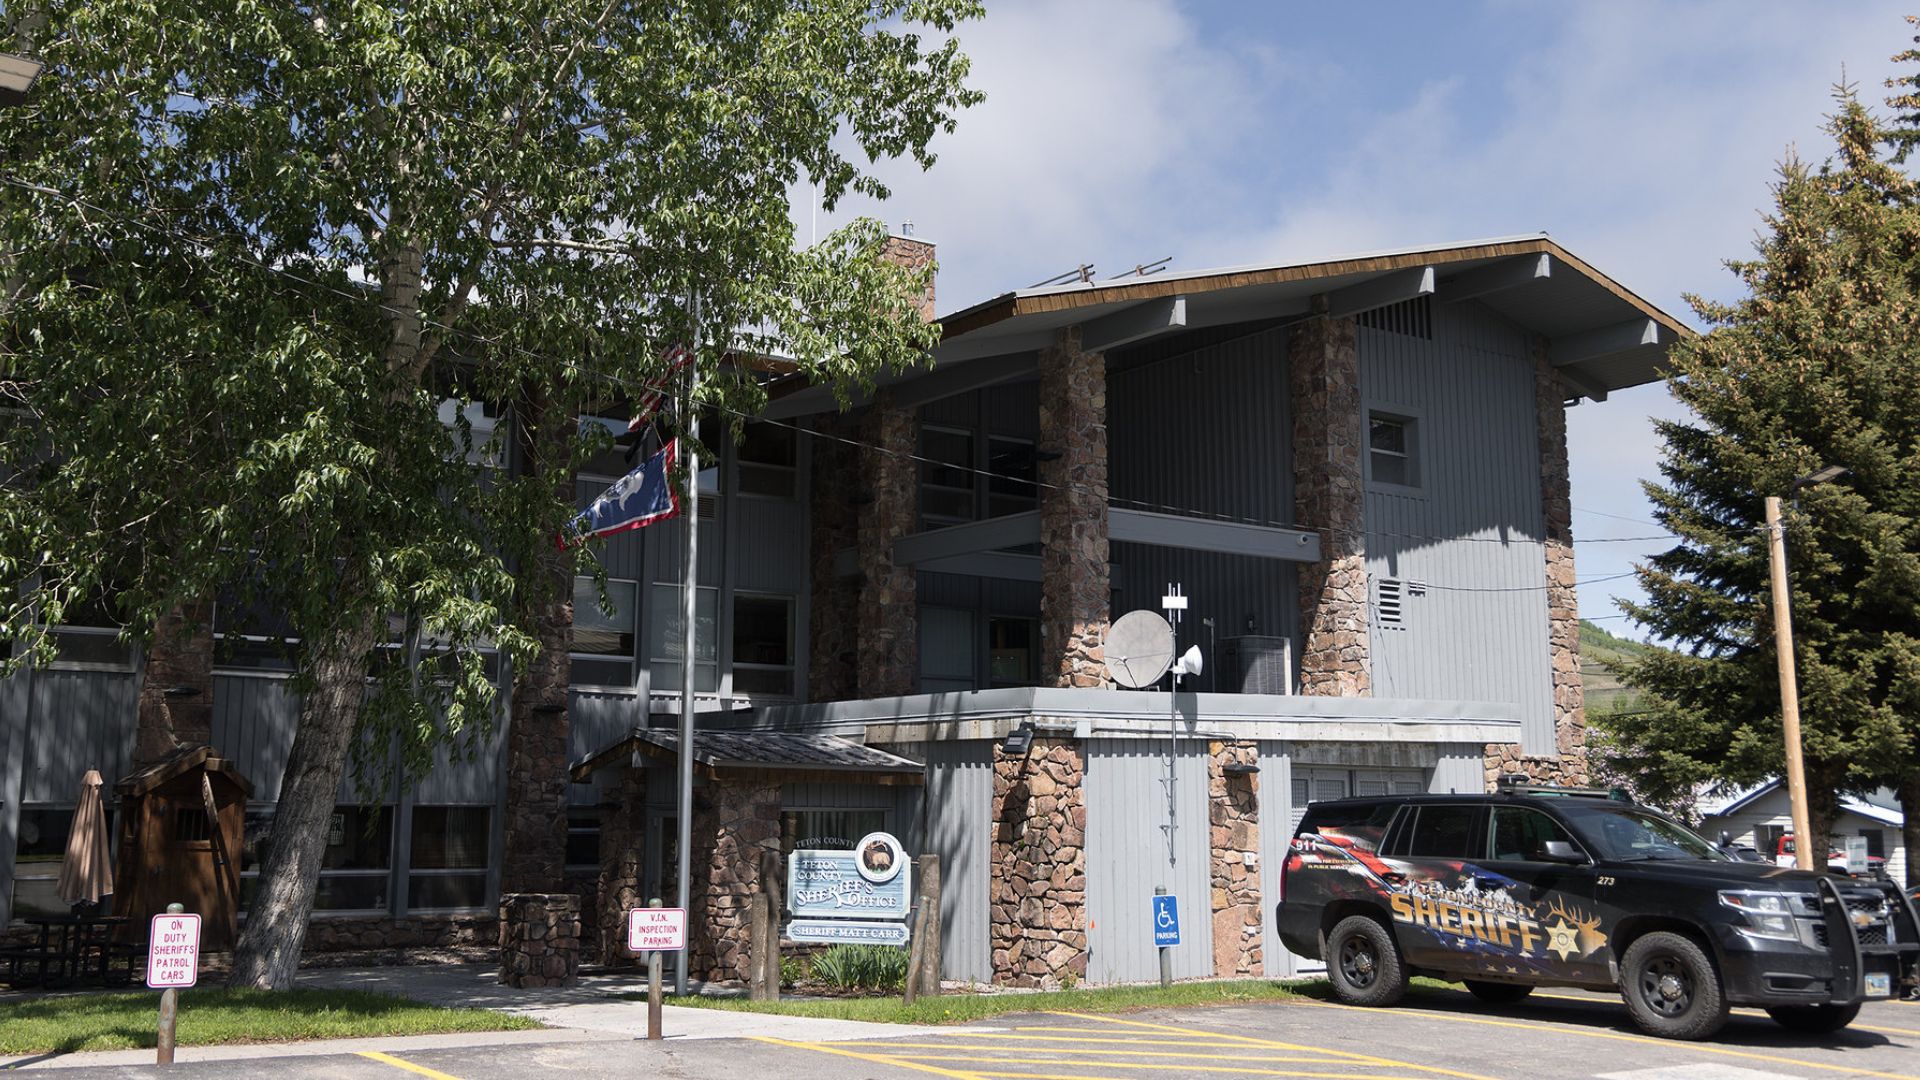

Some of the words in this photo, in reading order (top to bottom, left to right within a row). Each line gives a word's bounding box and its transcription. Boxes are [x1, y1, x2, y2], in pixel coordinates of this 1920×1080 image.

[1296, 840, 1316, 851] 911
[802, 861, 838, 870] TETON
[798, 872, 842, 881] COUNTY
[1597, 876, 1615, 886] 273
[847, 893, 897, 908] OFFICE
[1421, 884, 1469, 906] TETON
[1473, 895, 1537, 919] COUNTY
[171, 921, 182, 930] ON
[1391, 892, 1543, 953] SHERIFF
[639, 925, 677, 933] INSPECTION
[795, 927, 837, 937] SHERIFF
[839, 929, 868, 938] MATT
[870, 930, 900, 939] CARR
[164, 933, 187, 943] DUTY
[643, 936, 672, 945] PARKING
[154, 945, 195, 955] SHERIFFS
[156, 958, 190, 968] PATROL
[161, 970, 185, 980] CARS
